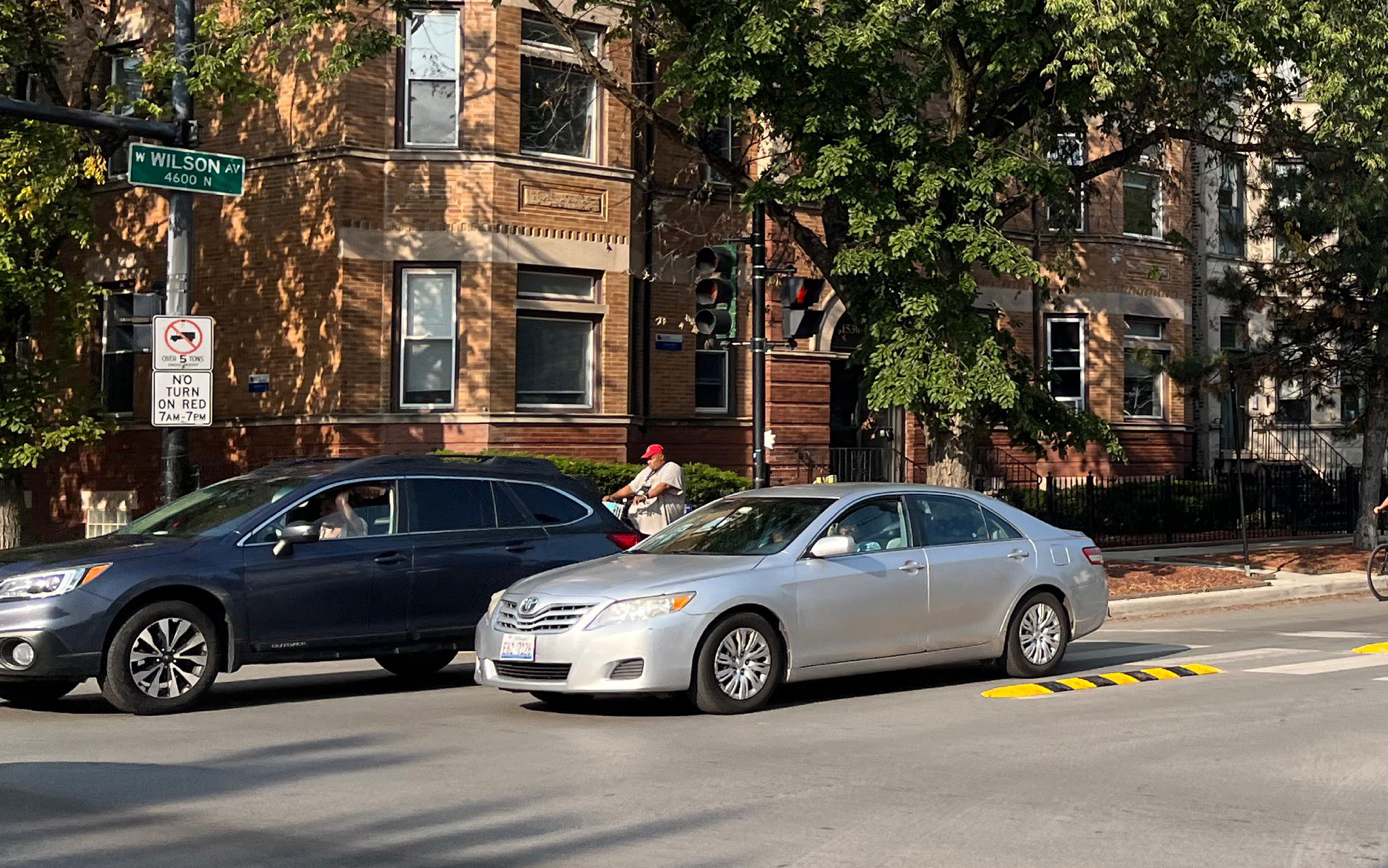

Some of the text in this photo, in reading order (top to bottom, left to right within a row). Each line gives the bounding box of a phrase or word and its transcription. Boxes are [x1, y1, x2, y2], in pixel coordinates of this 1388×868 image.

[135, 151, 241, 175] W WILSON AV
[164, 172, 213, 187] 4600 N
[161, 354, 205, 364] OVER 5 TONS
[172, 375, 193, 385] NO
[166, 387, 200, 397] TURN
[158, 399, 207, 410] ON RED
[158, 411, 207, 422] 7AM-7PM
